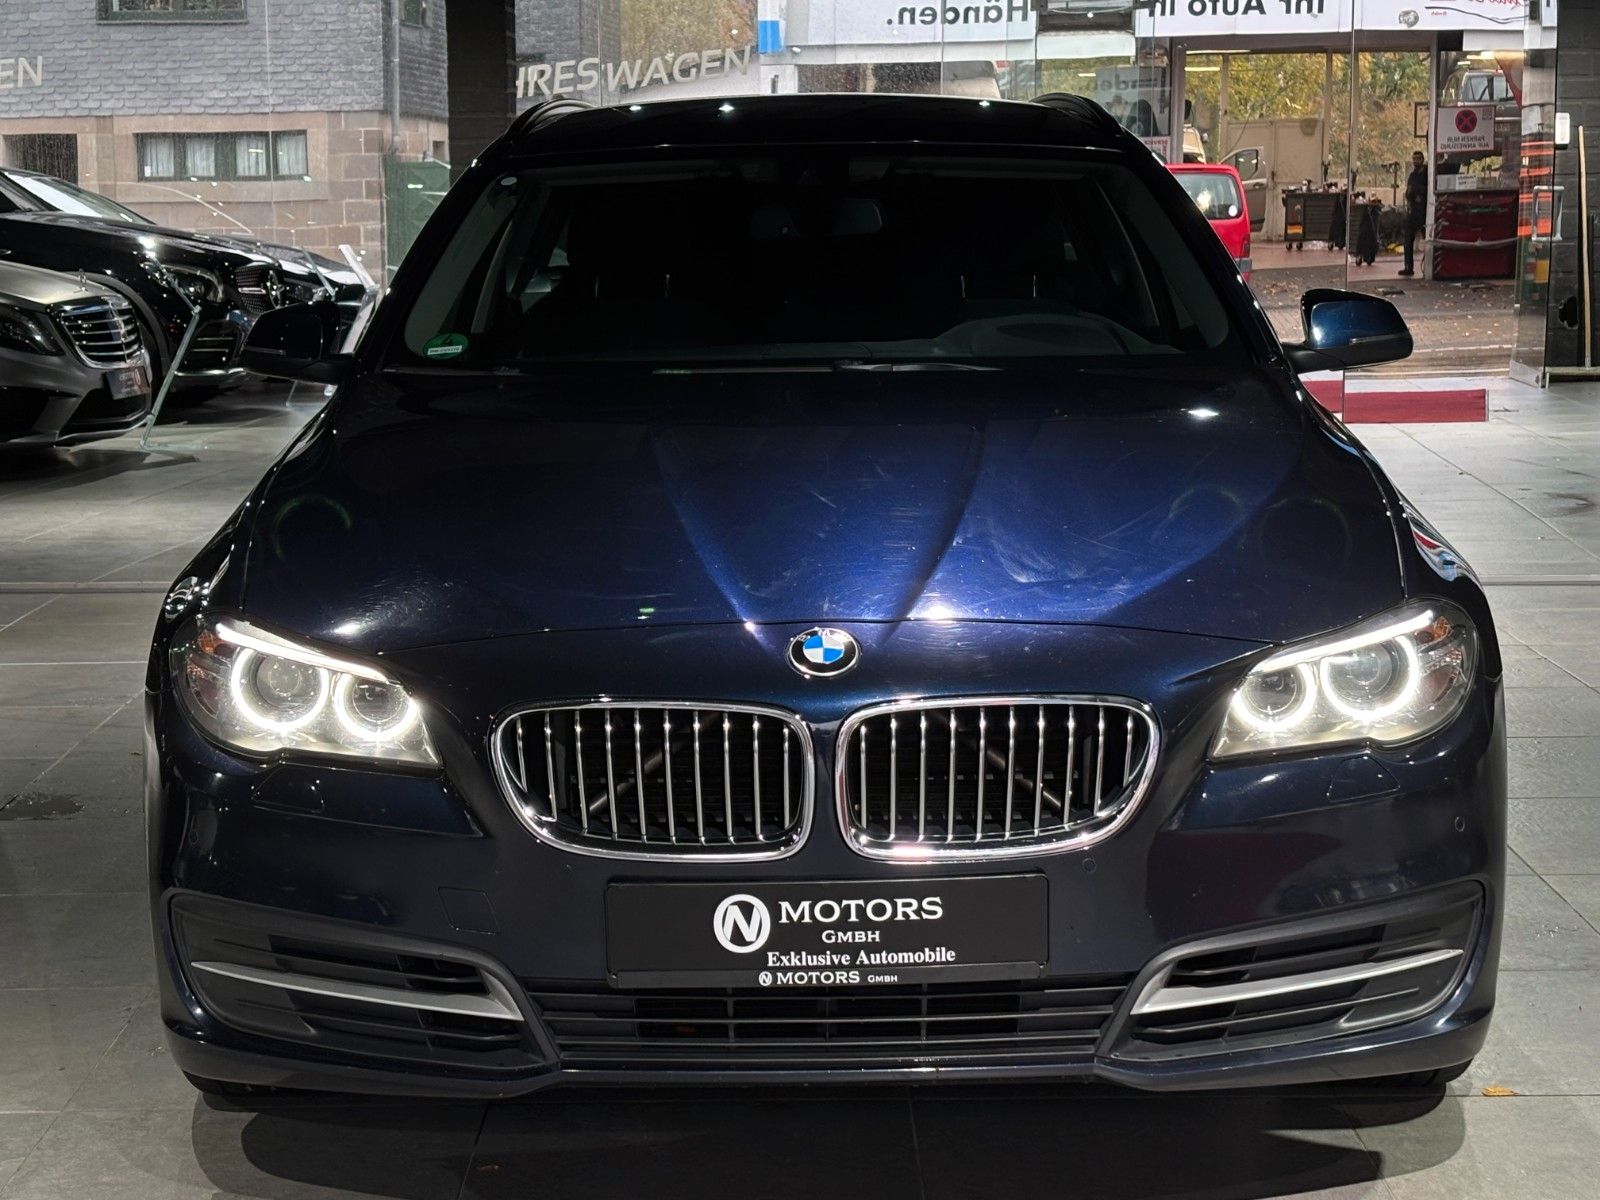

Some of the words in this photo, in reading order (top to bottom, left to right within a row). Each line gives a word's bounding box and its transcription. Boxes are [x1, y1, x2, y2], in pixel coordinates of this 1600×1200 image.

[778, 896, 943, 923] MOTORS
[822, 930, 881, 943] GMBH
[766, 951, 851, 967] Exklusive
[855, 947, 956, 965] Automobile
[776, 971, 860, 985] MOTORS
[867, 975, 898, 983] GMBH
